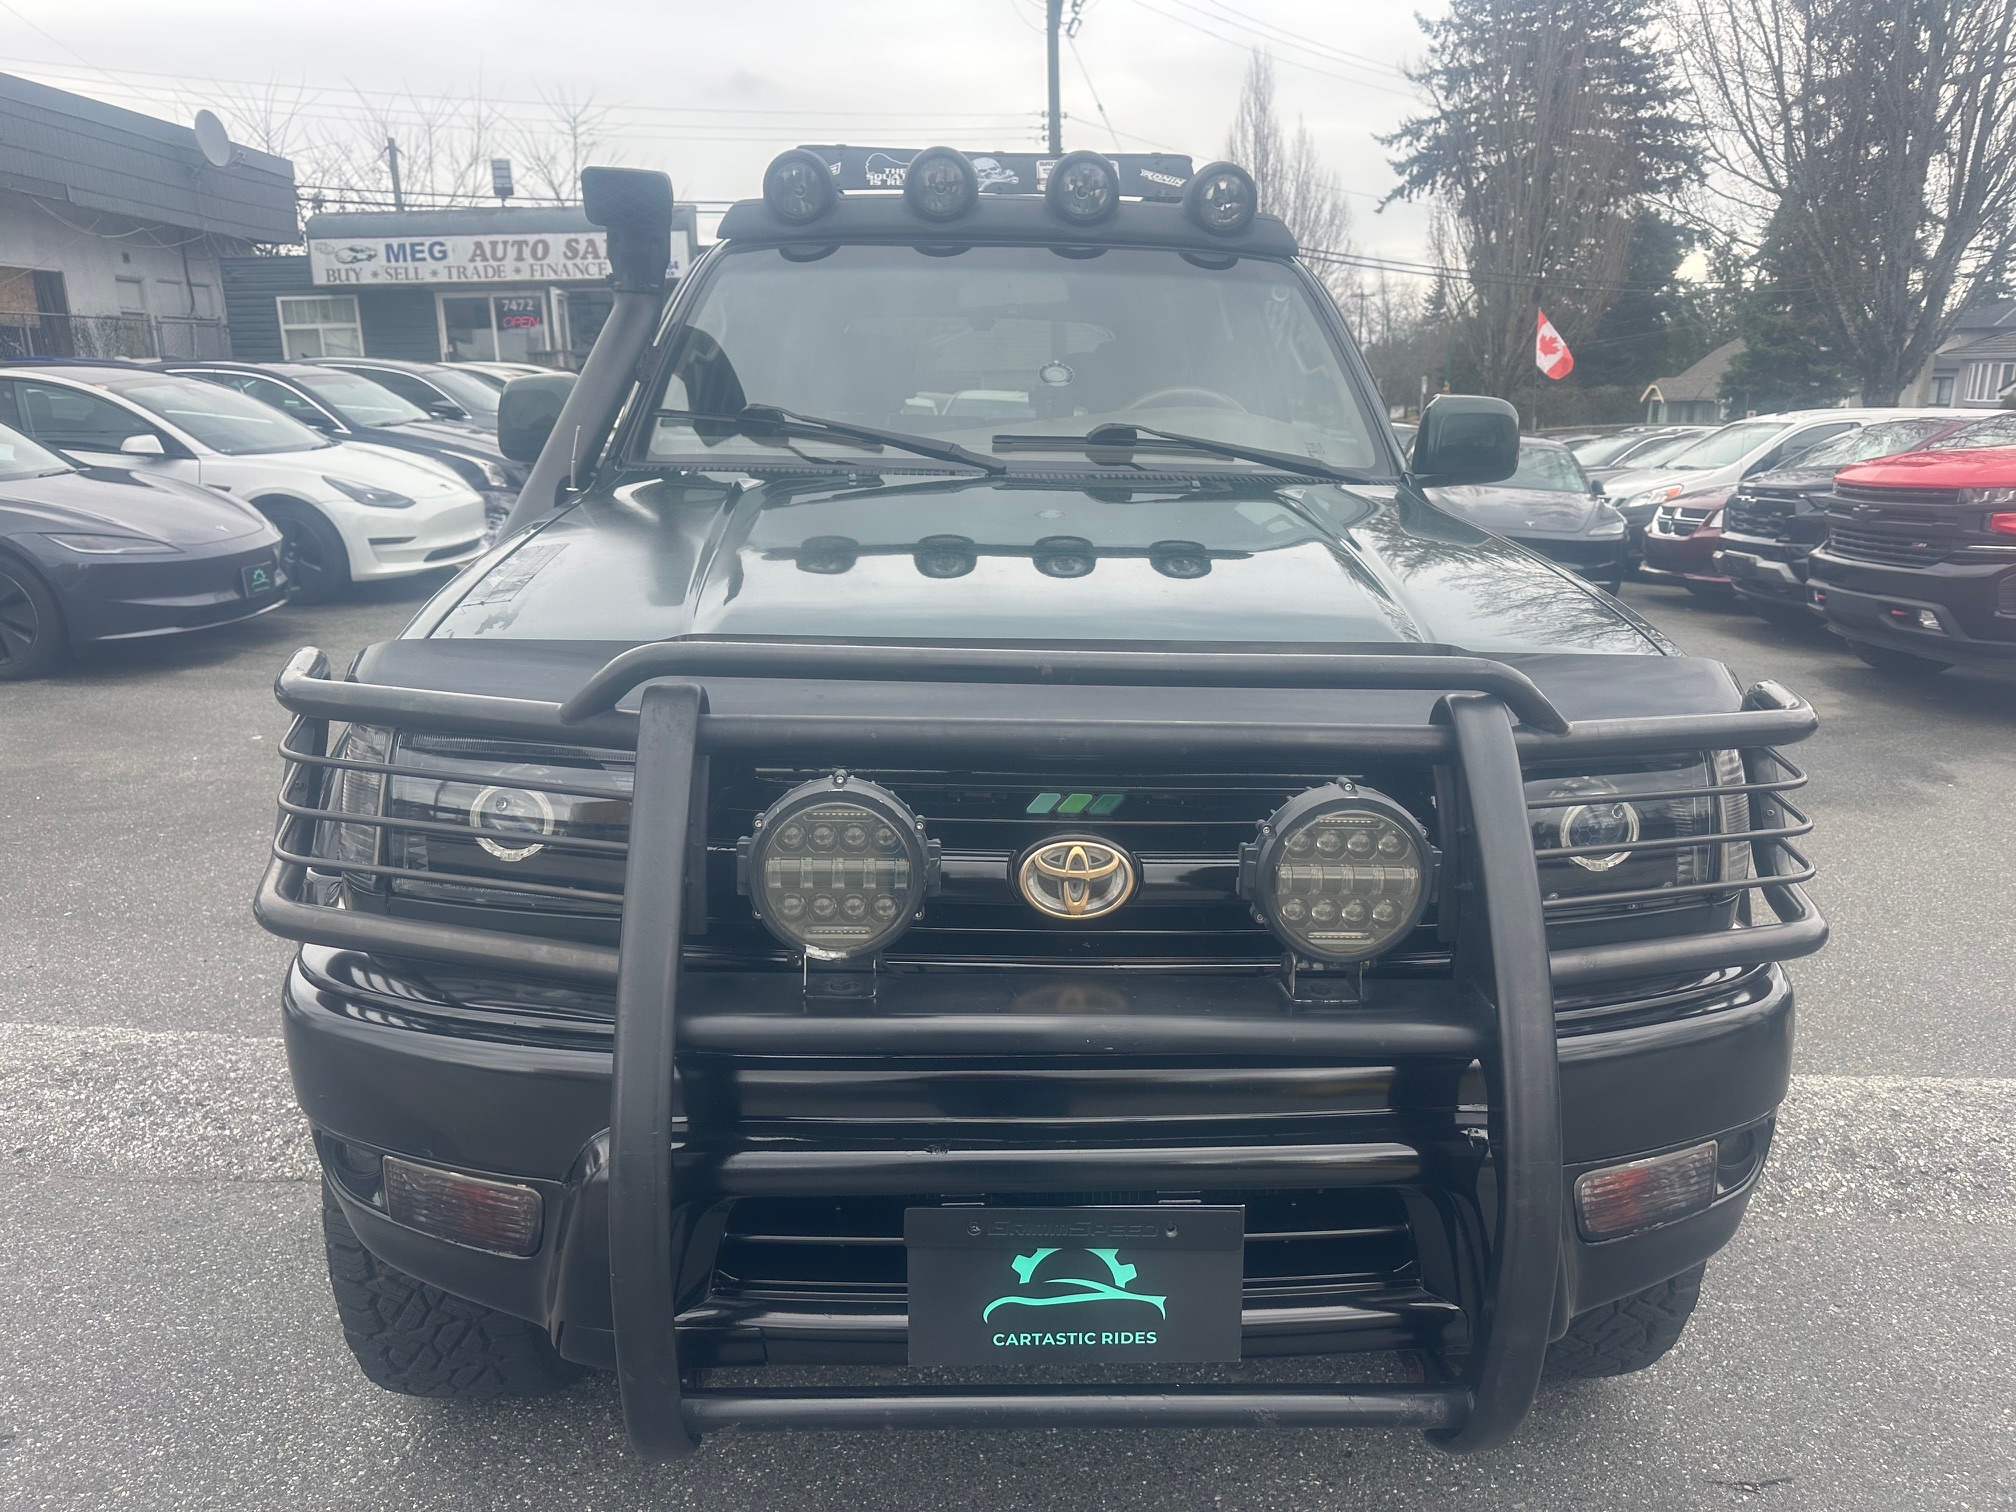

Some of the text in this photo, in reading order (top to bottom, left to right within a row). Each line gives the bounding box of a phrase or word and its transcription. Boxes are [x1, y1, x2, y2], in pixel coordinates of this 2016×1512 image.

[384, 237, 608, 263] MEG AUTO SA
[325, 261, 608, 283] BUY SELL TRADE FINANCE
[502, 300, 534, 311] 7472
[503, 316, 540, 328] OPEN
[992, 1331, 1158, 1346] CARTASTIC RIDES
